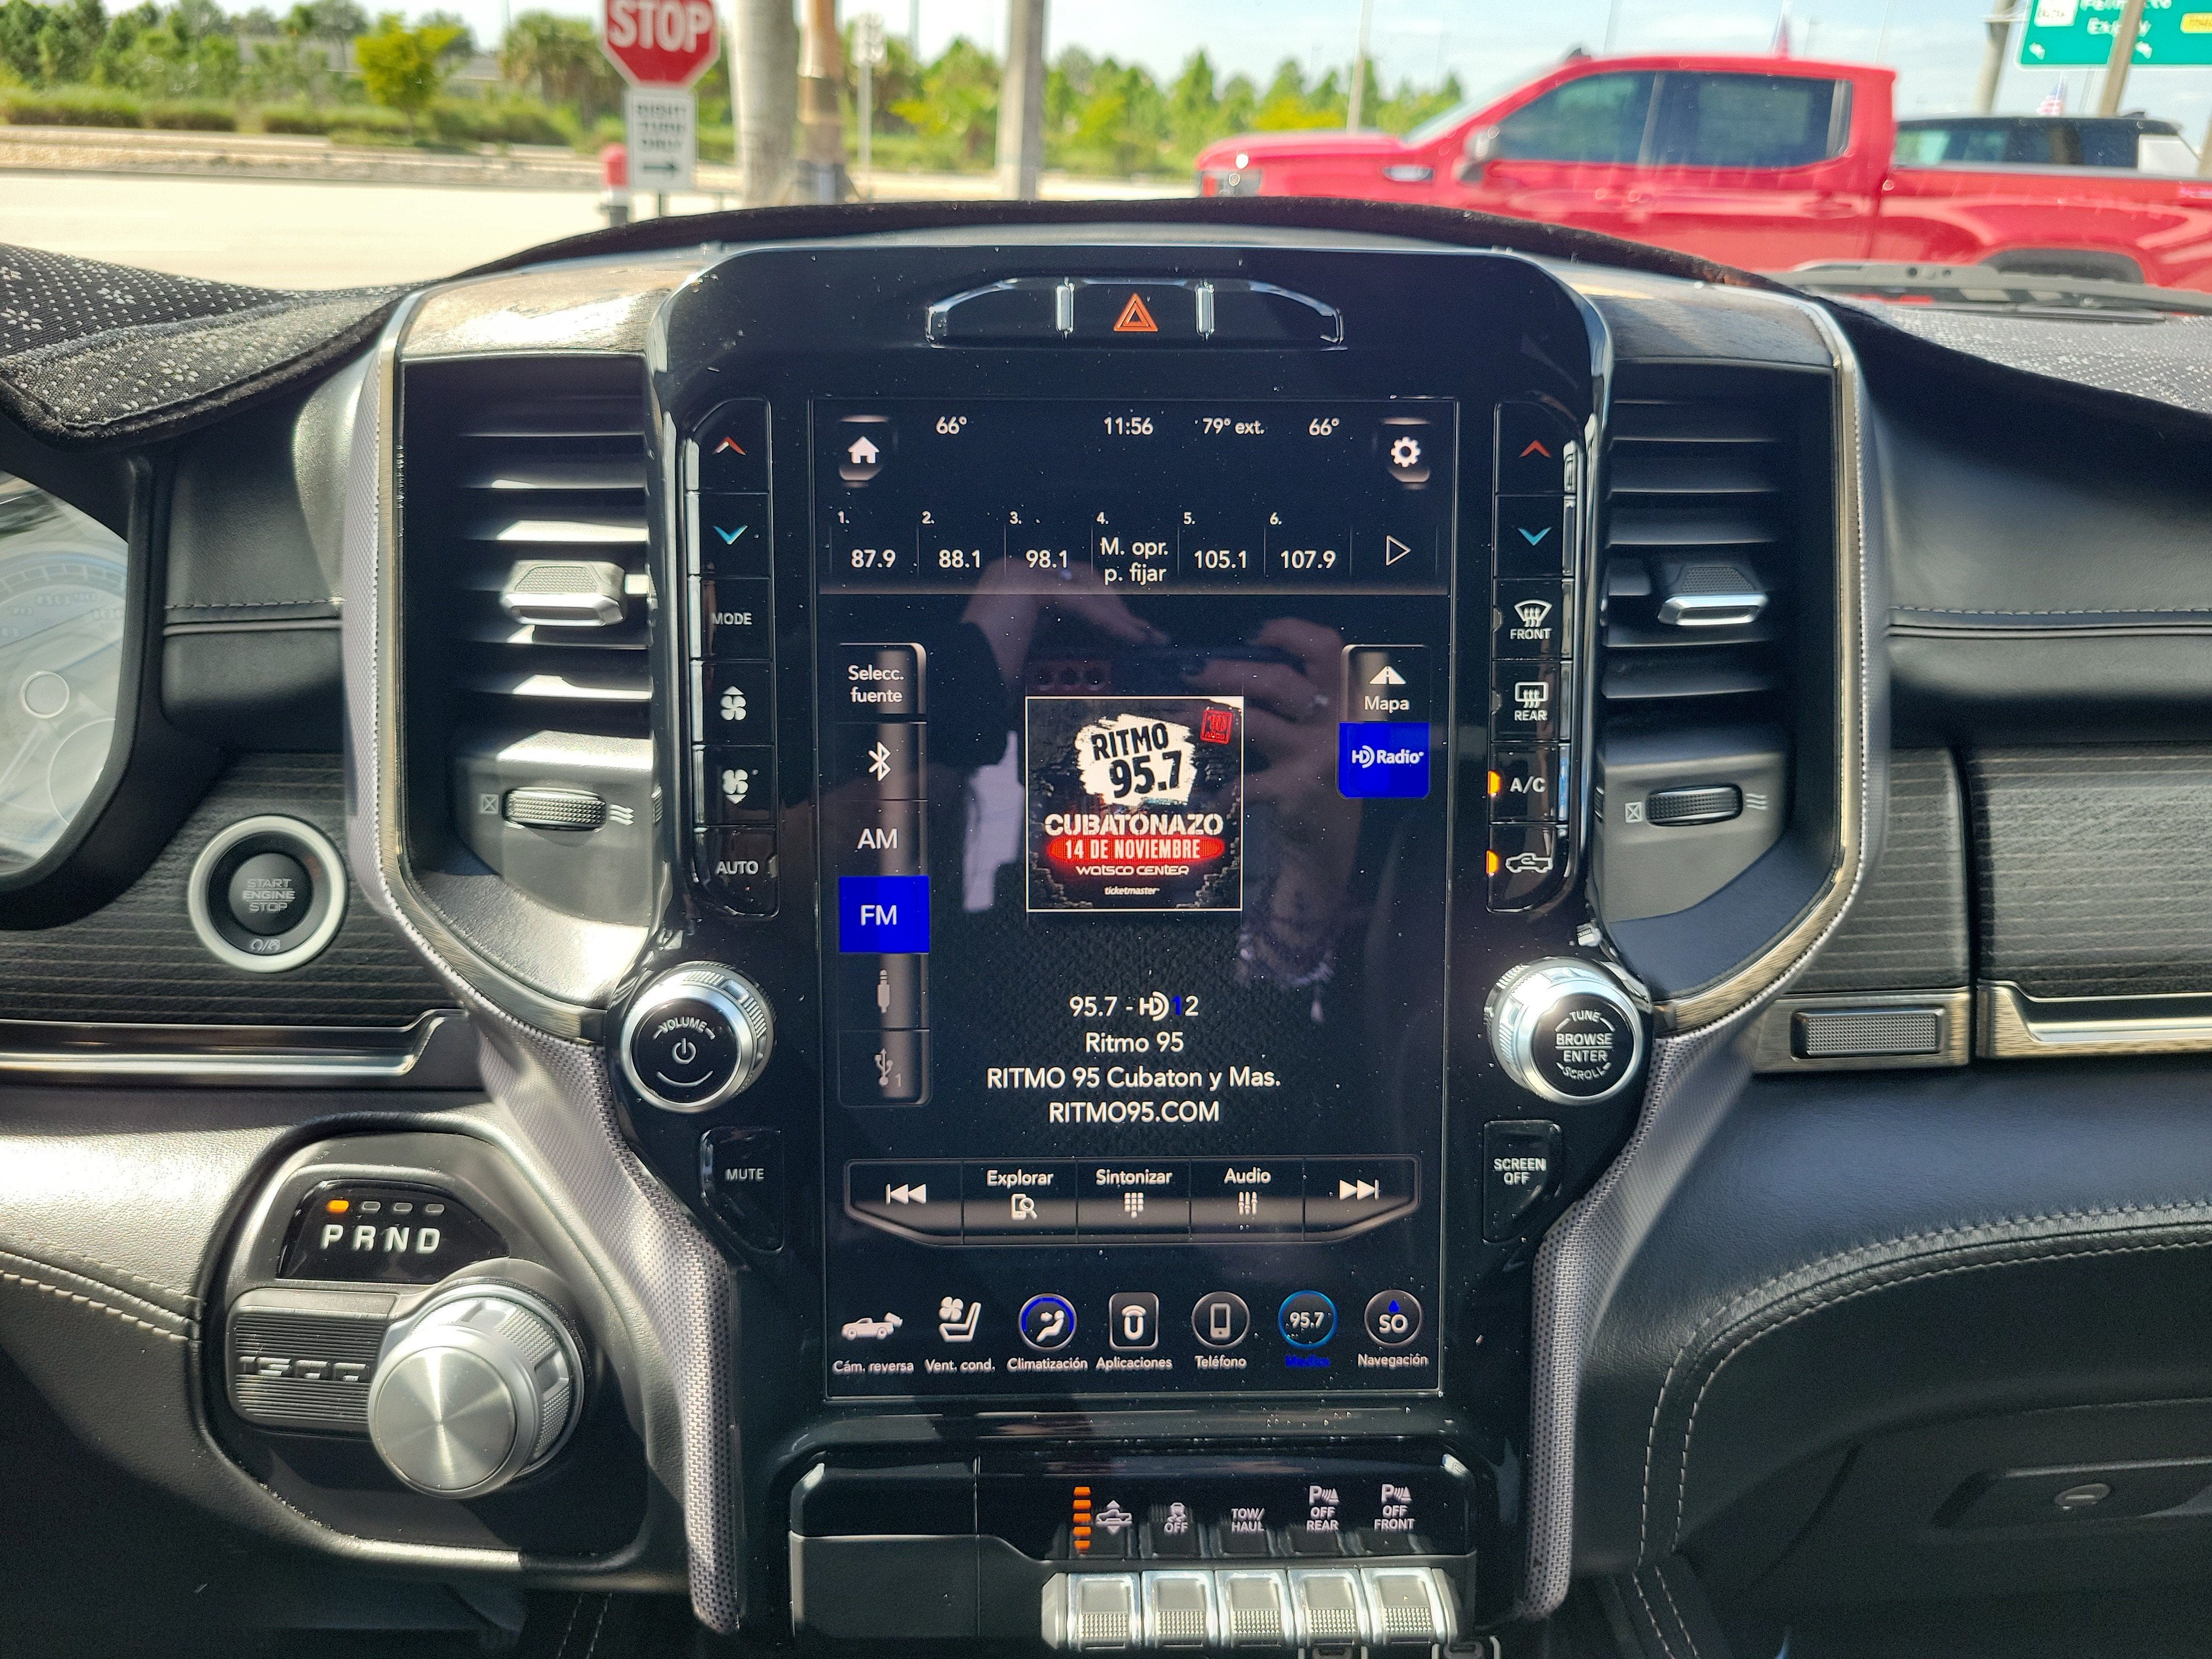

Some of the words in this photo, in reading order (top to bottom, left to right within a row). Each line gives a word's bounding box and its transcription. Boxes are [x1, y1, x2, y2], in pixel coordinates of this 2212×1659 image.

[608, 0, 711, 53] STOP
[936, 416, 967, 435] 66°
[1104, 417, 1153, 435] 11:56
[1235, 420, 1265, 435] ext.
[1308, 418, 1340, 436] 66°
[838, 511, 849, 524] 1.
[922, 511, 934, 524] 2.
[1009, 511, 1022, 524] 3.
[1097, 512, 1109, 524] 4.
[1183, 512, 1195, 525] 5.
[1269, 512, 1282, 525] 6.
[1101, 537, 1125, 556] M.
[1131, 541, 1168, 560] opr.
[851, 549, 896, 568] 87.9
[939, 549, 980, 568] 88.1
[1025, 549, 1068, 568] 98.1
[1194, 550, 1246, 569] 105.1
[1280, 550, 1336, 569] 107.9
[1104, 567, 1122, 586] p.
[1130, 562, 1167, 586] fijar
[712, 612, 752, 625] MODE
[1510, 628, 1552, 640] FRONT
[848, 664, 904, 681] Selecc.
[850, 686, 903, 703] fuente
[1364, 695, 1410, 713] Mapa
[1514, 710, 1548, 721] REAR
[1091, 723, 1169, 761] RITMO
[1109, 751, 1182, 798] 95.7
[1510, 775, 1546, 793] A/C
[1045, 814, 1224, 836] CUBATONAZO
[857, 828, 898, 849] AM
[1065, 839, 1084, 859] 14
[1091, 839, 1108, 859] DE
[1115, 839, 1200, 859] NOVIEMBRE
[715, 860, 759, 875] AUTO
[247, 879, 292, 888] START
[242, 890, 296, 900] ENGINE
[249, 902, 287, 913] STOP
[860, 905, 897, 926] FM
[1069, 996, 1118, 1017] 95.7
[1569, 1009, 1602, 1023] TUNE
[661, 1017, 707, 1033] VOLUME
[1085, 1031, 1149, 1053] Ritmo
[1156, 1031, 1184, 1053] 95
[1555, 1032, 1613, 1047] BROWSE
[1563, 1049, 1608, 1063] ENTER
[987, 1068, 1065, 1089] RITMO
[1071, 1068, 1099, 1088] 95
[1107, 1065, 1202, 1088] Cubaton
[1209, 1071, 1222, 1091] y
[1229, 1065, 1281, 1088] Mas.
[1561, 1065, 1606, 1081] SCROLL
[1048, 1101, 1220, 1124] RITMO95.COM
[1494, 1158, 1547, 1172] SCREEN
[725, 1167, 765, 1182] MUTE
[986, 1169, 1053, 1188] Explorar
[1096, 1168, 1173, 1186] Sintonizar
[1224, 1167, 1272, 1184] Audio
[1503, 1172, 1531, 1186] OFF
[1289, 1311, 1324, 1329] 95.7
[1378, 1314, 1408, 1334] SO
[832, 1359, 865, 1373] Cám.
[868, 1362, 914, 1373] reversa
[924, 1359, 957, 1373] Vent.
[960, 1358, 995, 1373] cond.
[1007, 1357, 1088, 1372] Climatización
[1096, 1357, 1172, 1373] Aplicaciones
[1195, 1353, 1247, 1369] Teléfono
[1358, 1353, 1428, 1369] Navegación
[1310, 1506, 1335, 1519] OFF
[1382, 1505, 1408, 1518] OFF
[1164, 1522, 1188, 1534] OFF
[1232, 1521, 1265, 1533] HAUL
[1306, 1519, 1339, 1532] REAR
[1374, 1518, 1415, 1531] FRONT
